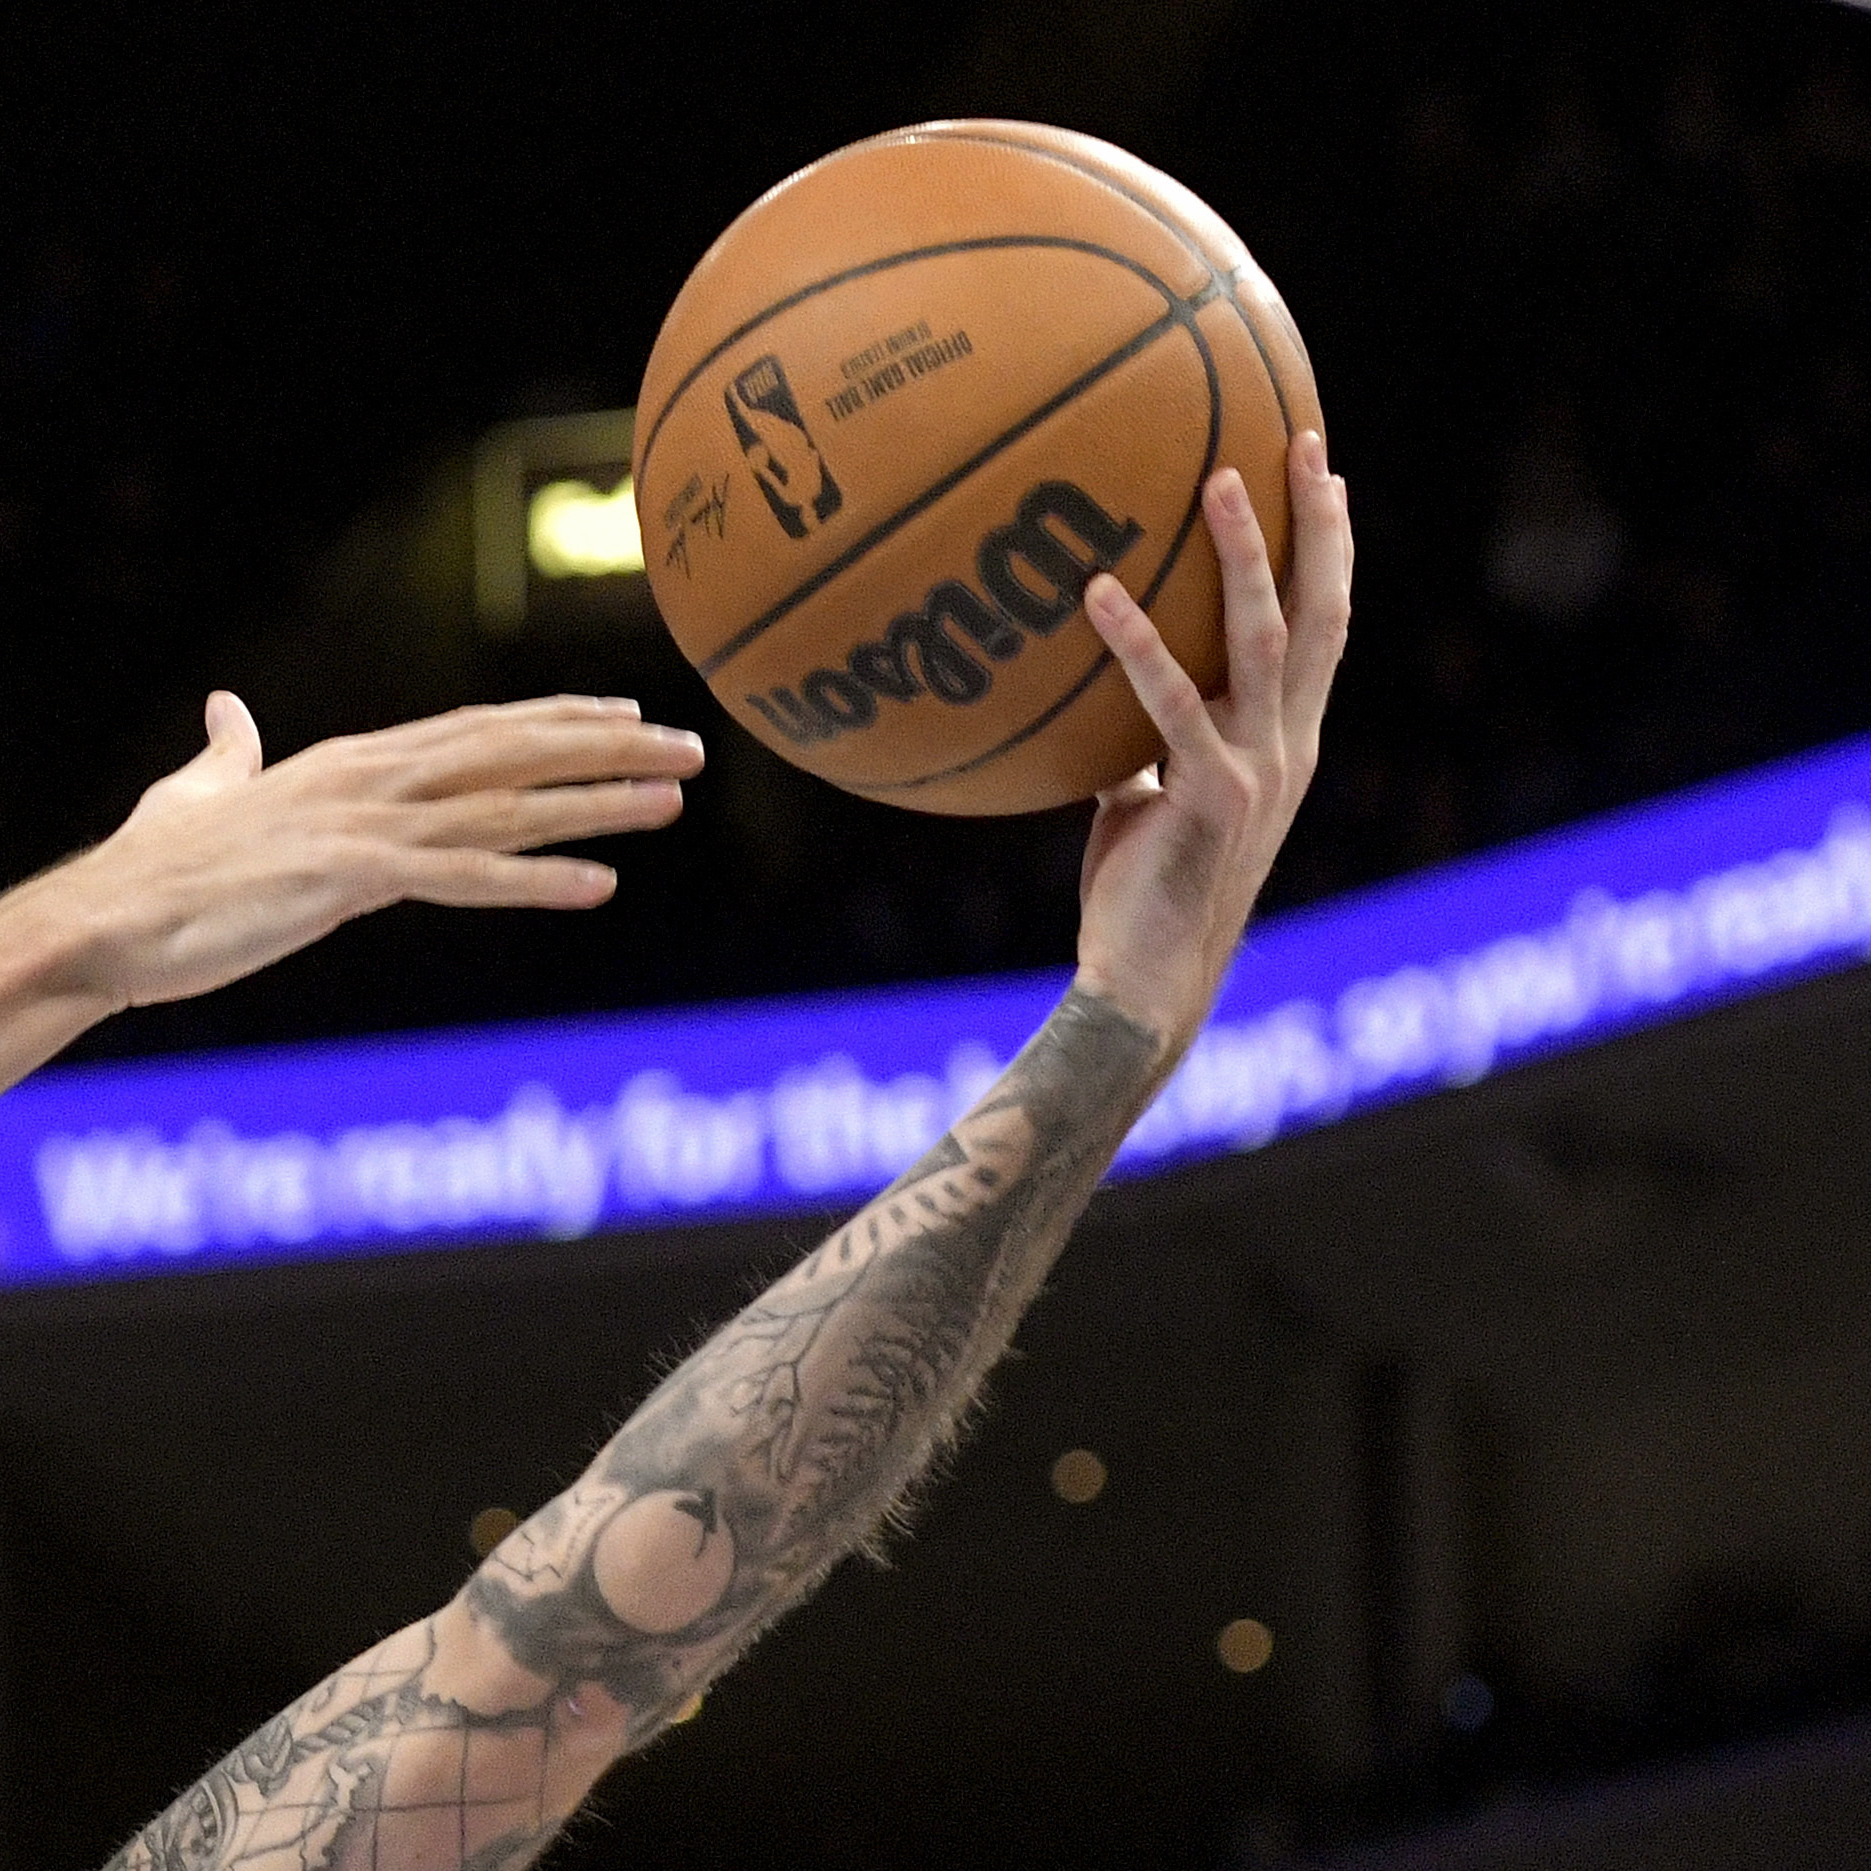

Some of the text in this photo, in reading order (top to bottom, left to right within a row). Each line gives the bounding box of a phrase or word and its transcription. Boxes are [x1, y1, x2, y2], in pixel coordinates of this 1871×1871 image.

[862, 362, 907, 401] GAME
[824, 385, 866, 422] BALL
[743, 479, 1147, 749] Wilson
